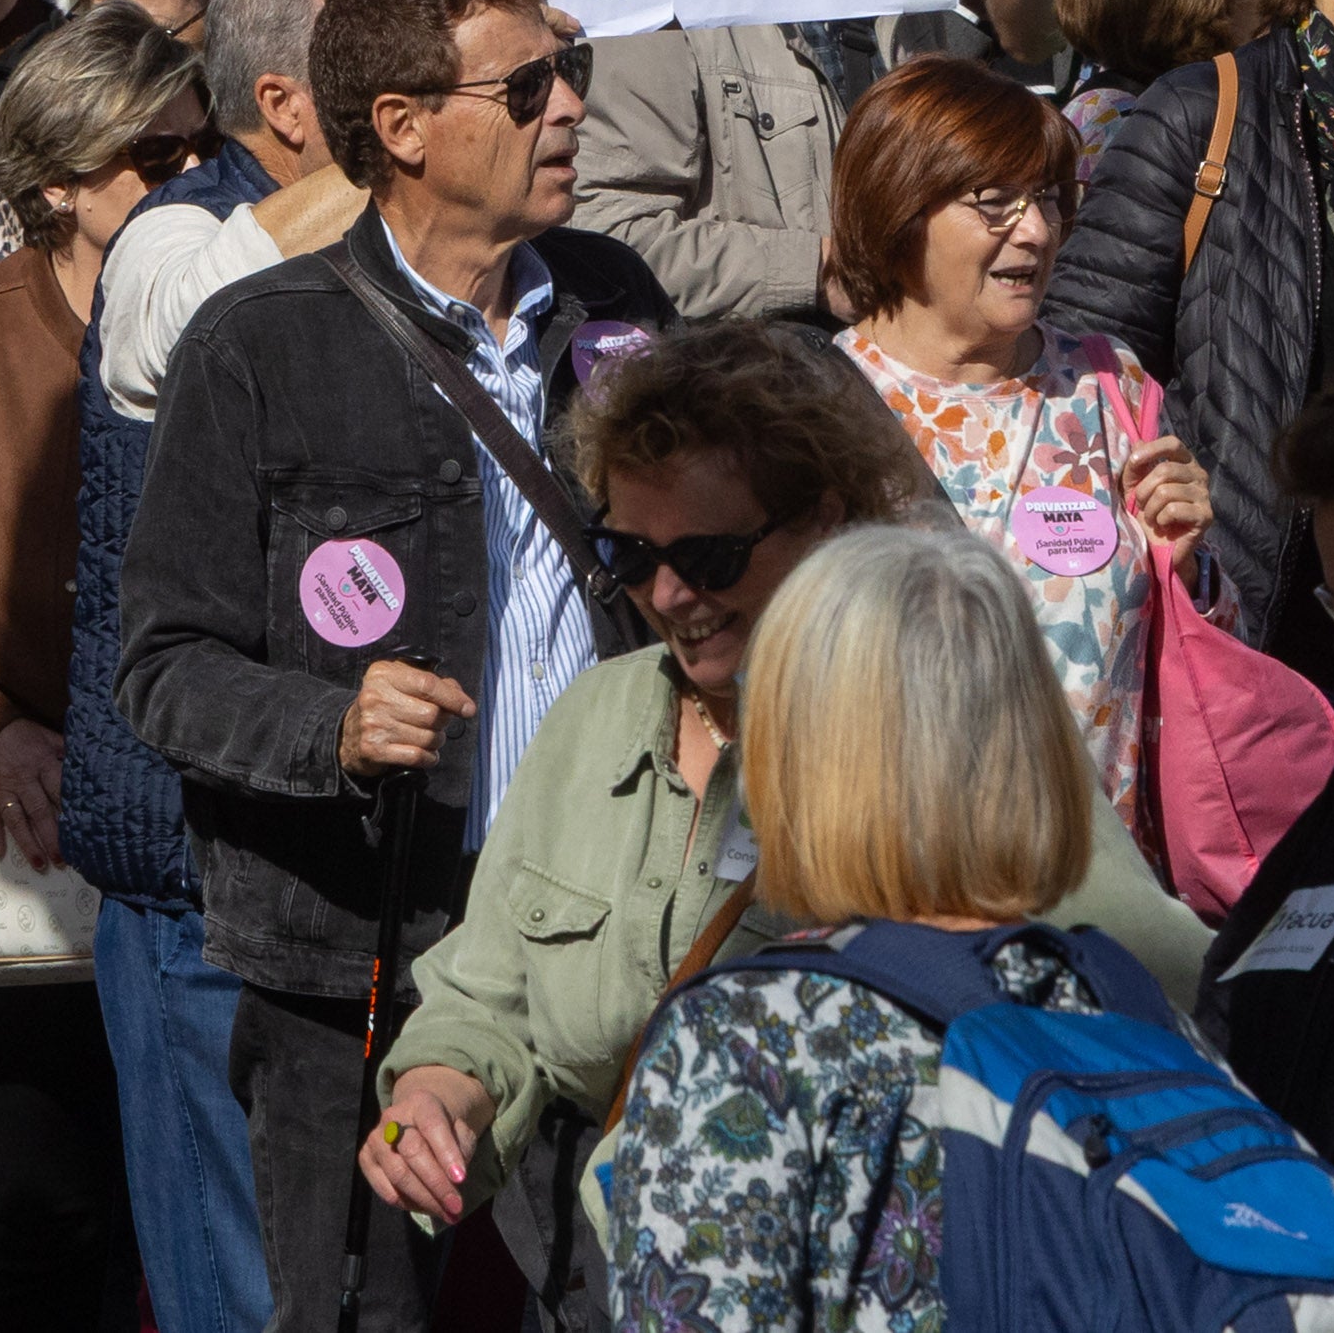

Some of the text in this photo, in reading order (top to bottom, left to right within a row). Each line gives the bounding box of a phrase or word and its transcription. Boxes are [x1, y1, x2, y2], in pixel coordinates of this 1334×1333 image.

[1025, 501, 1097, 513] PRIVATIZAR
[1043, 512, 1083, 523] MATA
[1074, 537, 1104, 547] Pública
[1048, 547, 1067, 556] para
[347, 565, 378, 605] MATA
[348, 545, 400, 611] PRIVATIZAR
[315, 587, 330, 606] para
[338, 605, 359, 636] Pública
